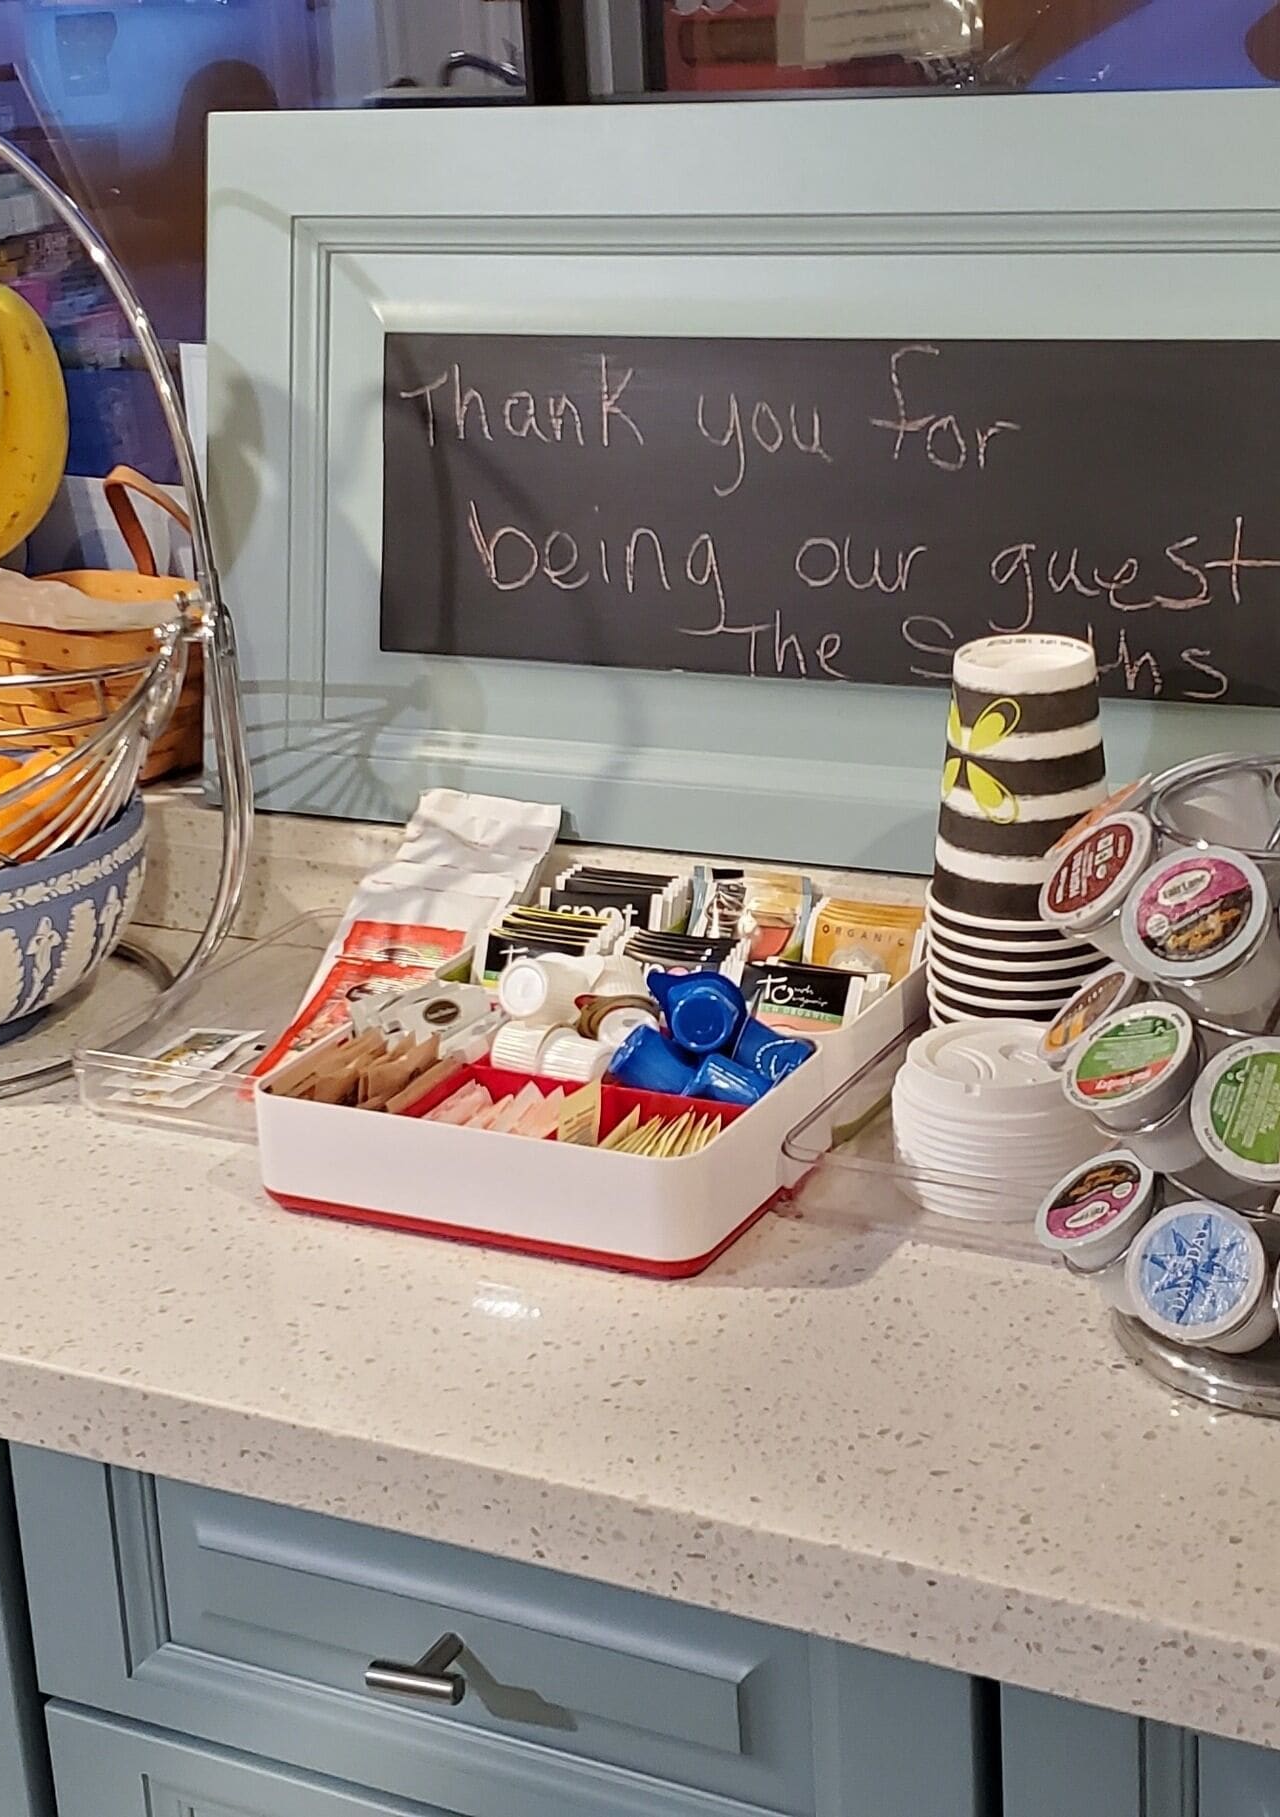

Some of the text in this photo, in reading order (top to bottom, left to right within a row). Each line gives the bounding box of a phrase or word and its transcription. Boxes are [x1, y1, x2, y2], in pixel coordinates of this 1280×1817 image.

[399, 344, 1024, 496] Thank you for
[468, 499, 726, 636] being
[794, 535, 928, 594] our
[723, 608, 1234, 699] The Shs
[822, 924, 906, 947] ORGANIC
